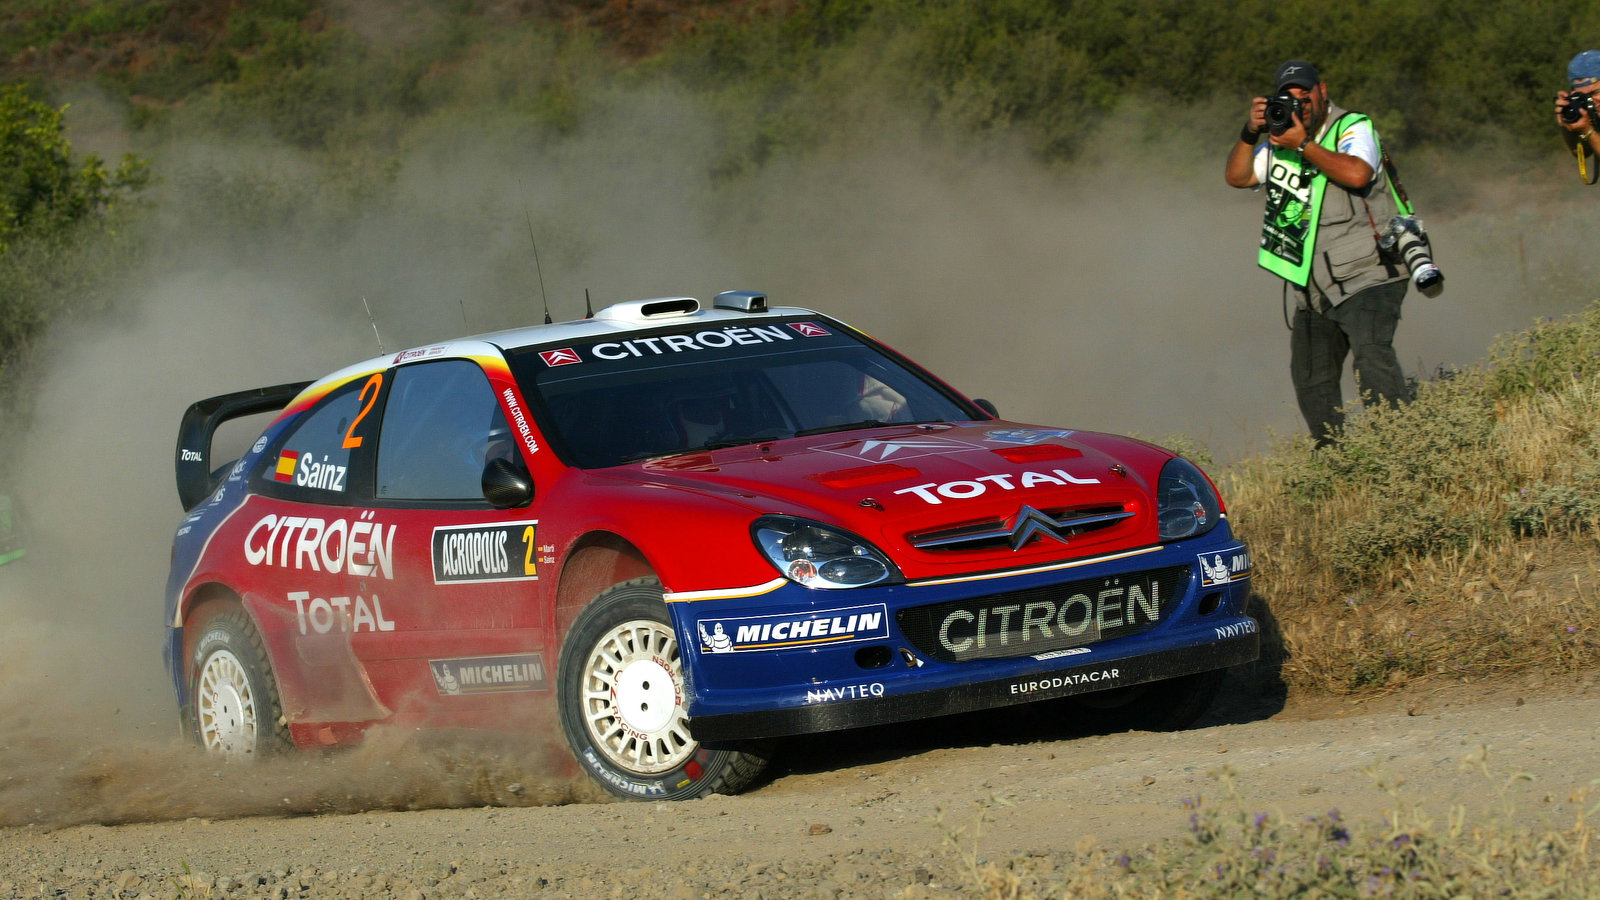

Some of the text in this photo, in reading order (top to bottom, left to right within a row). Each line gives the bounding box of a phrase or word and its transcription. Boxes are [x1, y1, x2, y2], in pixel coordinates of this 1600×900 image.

[592, 325, 792, 360] CITROËN
[342, 373, 383, 449] 2
[503, 388, 539, 455] WWW.CITROEN.COM
[297, 452, 346, 492] Sainz
[894, 469, 1100, 504] TOTAL
[244, 510, 397, 579] CITROËN
[442, 526, 537, 575] ACROPOLIS 2
[736, 612, 881, 642] MICHELIN
[939, 579, 1159, 652] CITROËN
[460, 663, 542, 685] MICHELIN
[1010, 669, 1120, 694] EURODATACAR
[805, 683, 885, 703] NAVTEQ
[611, 705, 648, 741] RACING
